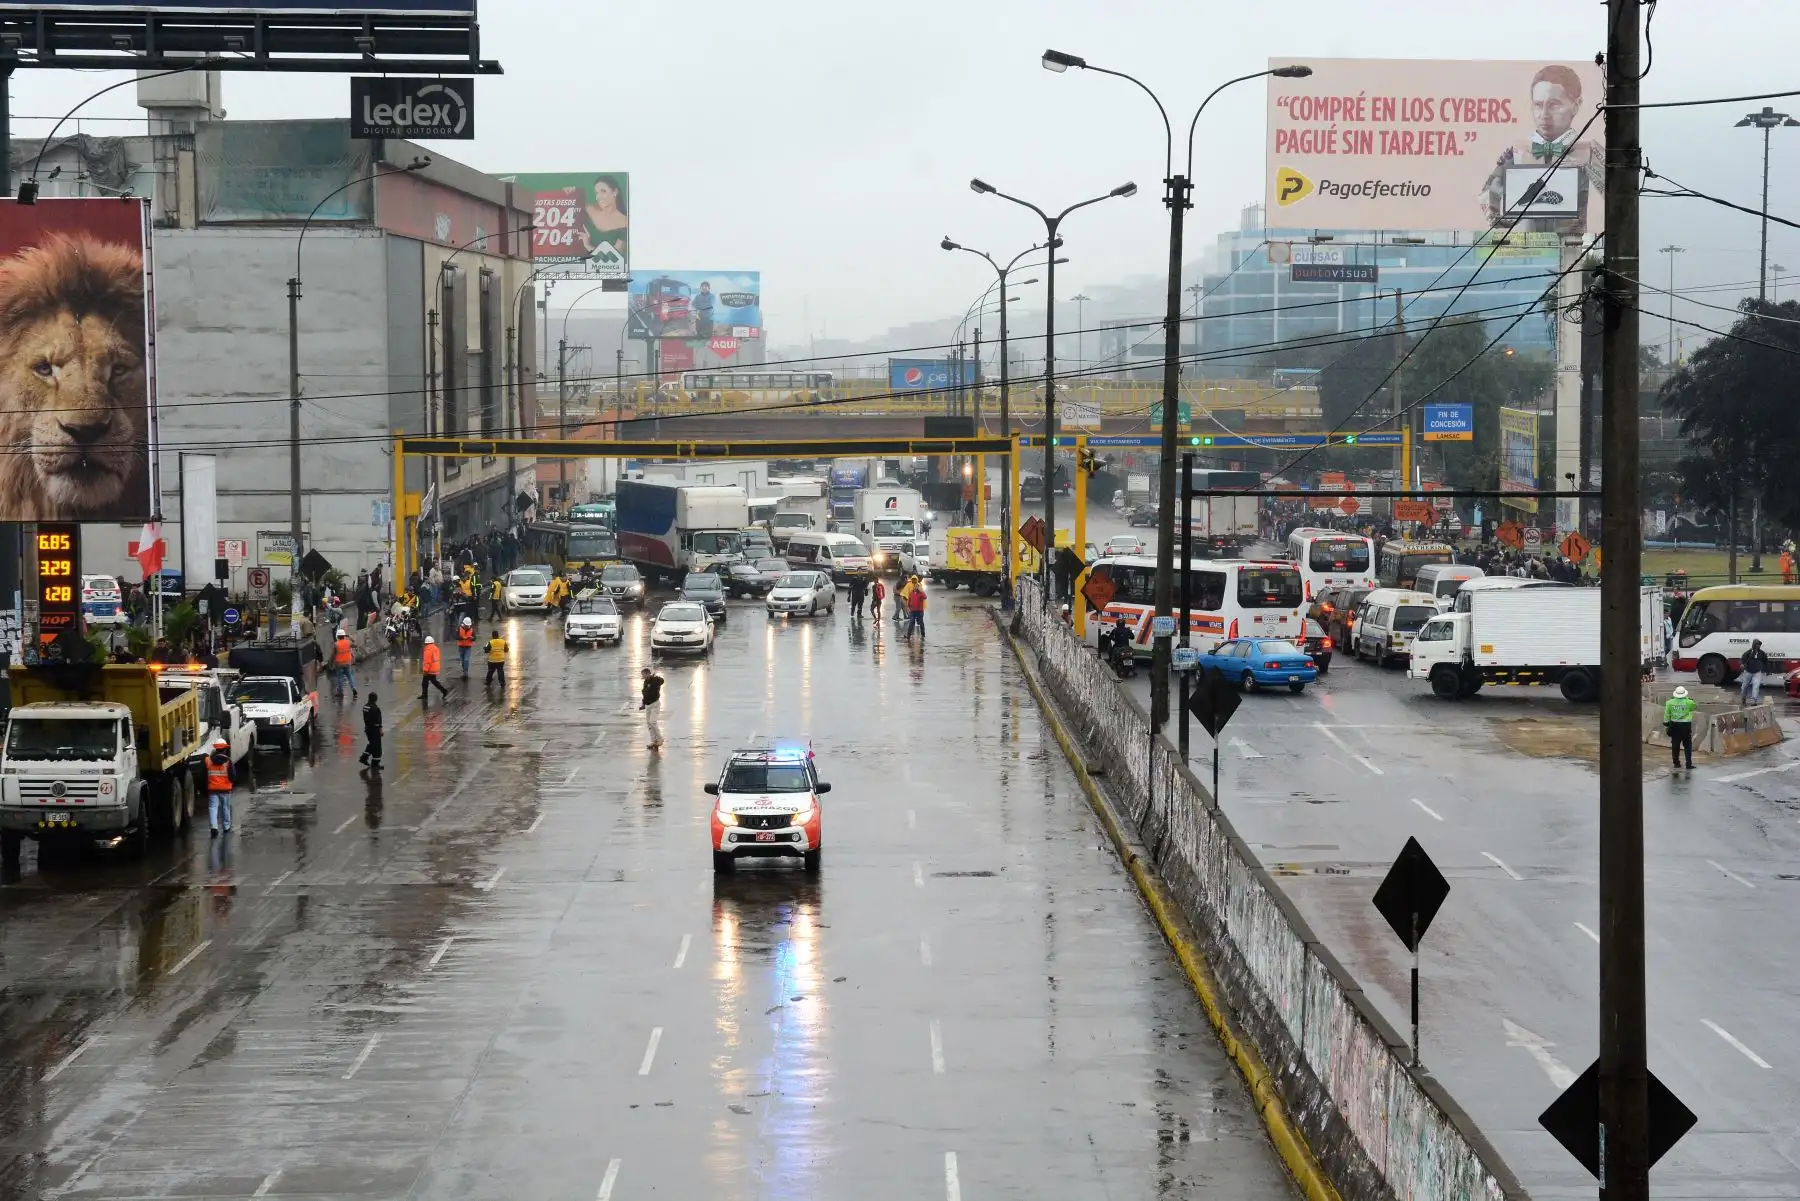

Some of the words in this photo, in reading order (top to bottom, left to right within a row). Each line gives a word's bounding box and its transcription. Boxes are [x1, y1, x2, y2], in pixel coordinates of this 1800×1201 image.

[363, 95, 452, 126] ledex
[1371, 97, 1396, 122] EN
[1401, 97, 1435, 123] LOS
[1439, 97, 1518, 124] CYBERS.
[363, 127, 401, 135] DIGITAL
[406, 127, 452, 135] OUTDOOR
[1275, 123, 1337, 155] PAGUÉ
[1342, 130, 1374, 156] SIN
[1318, 179, 1432, 200] PagoEfectivo
[1295, 268, 1375, 279] puntovisual
[1430, 419, 1466, 428] CONCESIÓN
